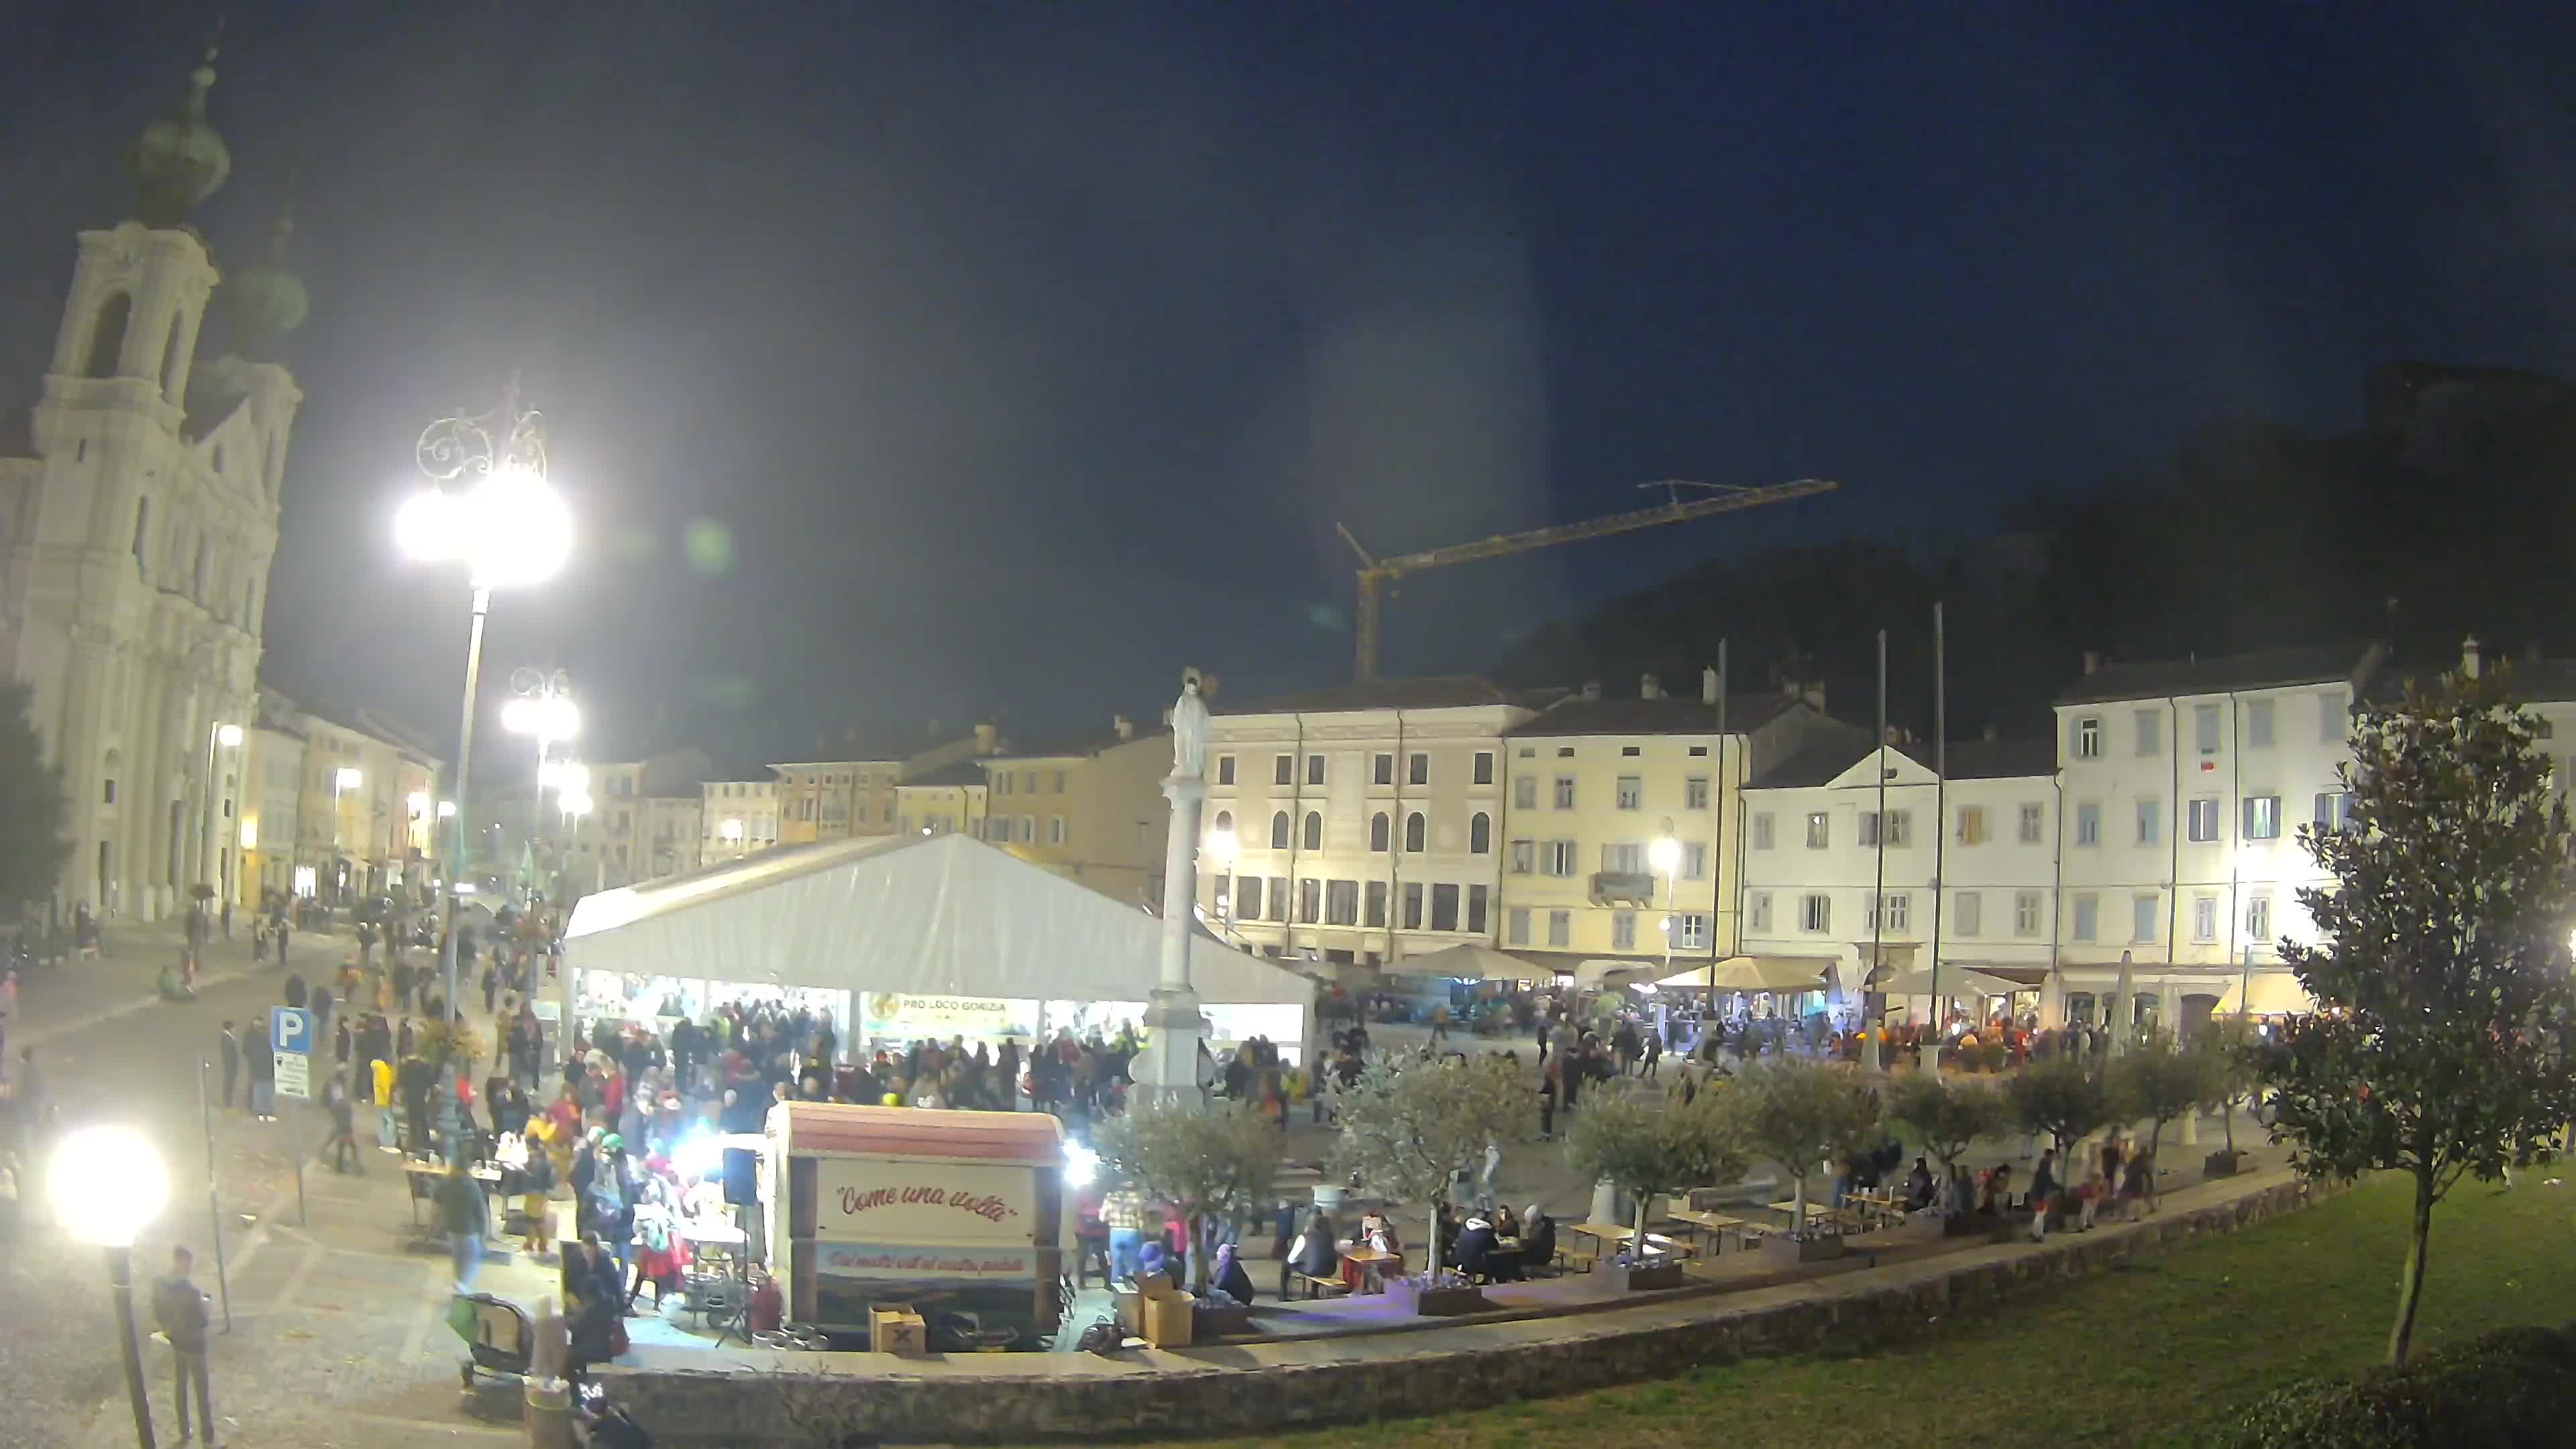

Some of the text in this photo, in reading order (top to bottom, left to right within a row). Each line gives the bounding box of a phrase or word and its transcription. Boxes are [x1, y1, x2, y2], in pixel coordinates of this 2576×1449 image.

[904, 1000, 1006, 1012] PRO LOCO GORIZIA
[279, 1011, 304, 1047] P
[901, 1186, 945, 1205] una
